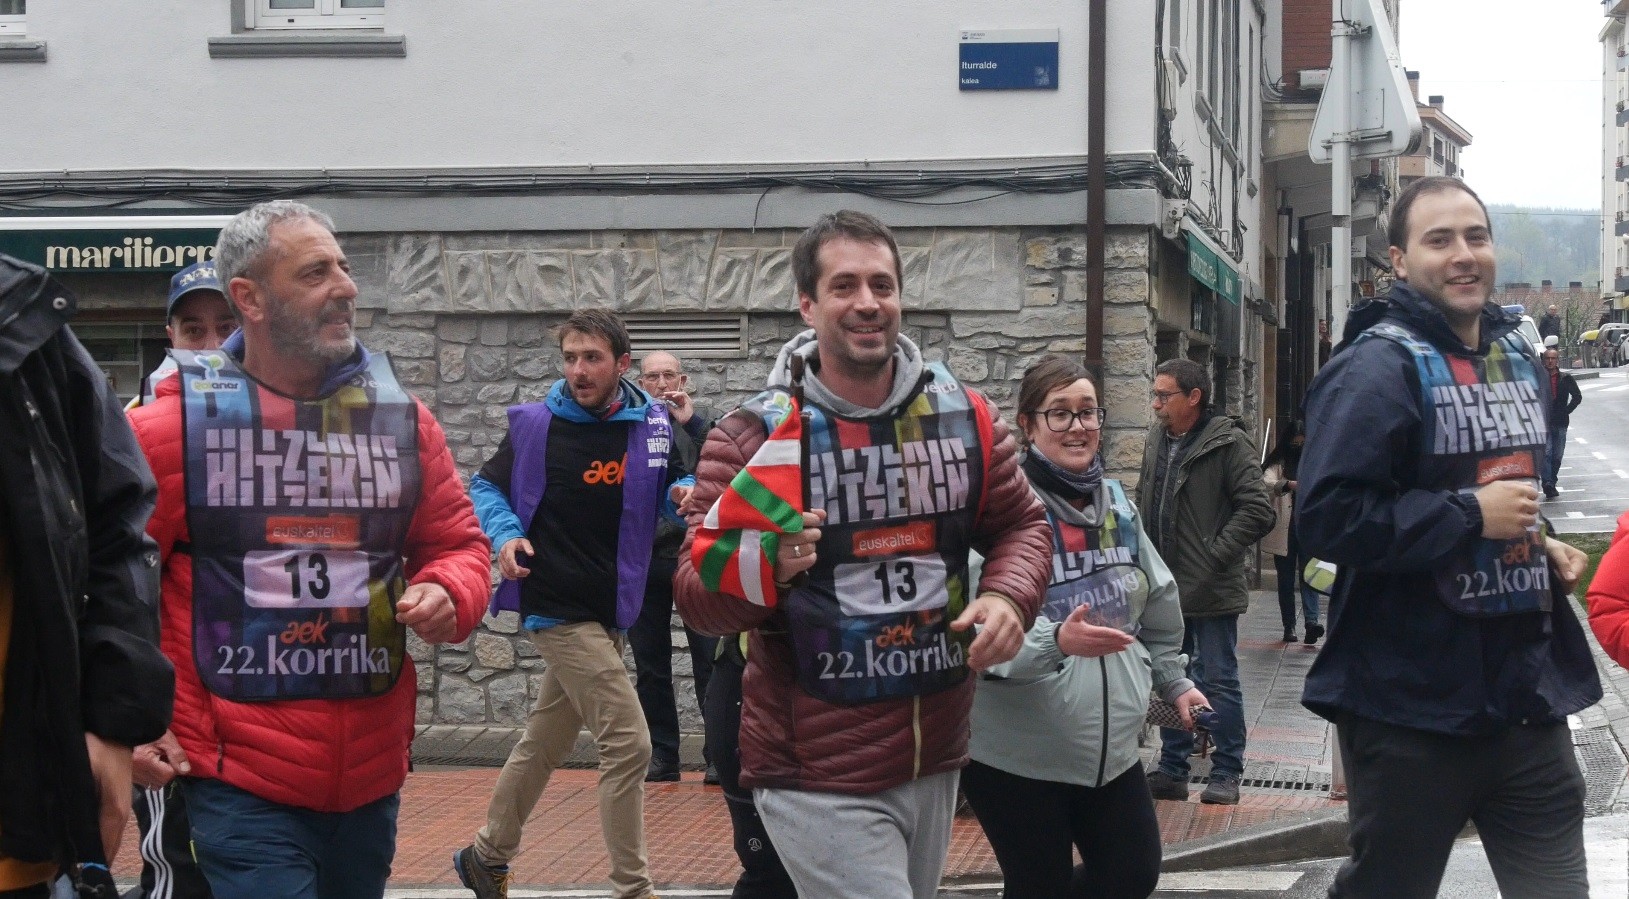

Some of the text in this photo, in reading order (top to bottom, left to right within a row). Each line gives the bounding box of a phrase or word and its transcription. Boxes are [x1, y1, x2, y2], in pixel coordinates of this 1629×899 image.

[962, 61, 997, 69] Iturralde
[206, 428, 400, 508] HITZEKIN
[272, 524, 335, 538] euskaltel
[858, 533, 915, 552] euskaltel
[284, 553, 331, 600] 13
[874, 561, 918, 604] 13
[278, 612, 329, 644] aek
[875, 615, 915, 647] aek
[216, 634, 391, 676] 22.korrika
[817, 632, 964, 680] 22.korrika
